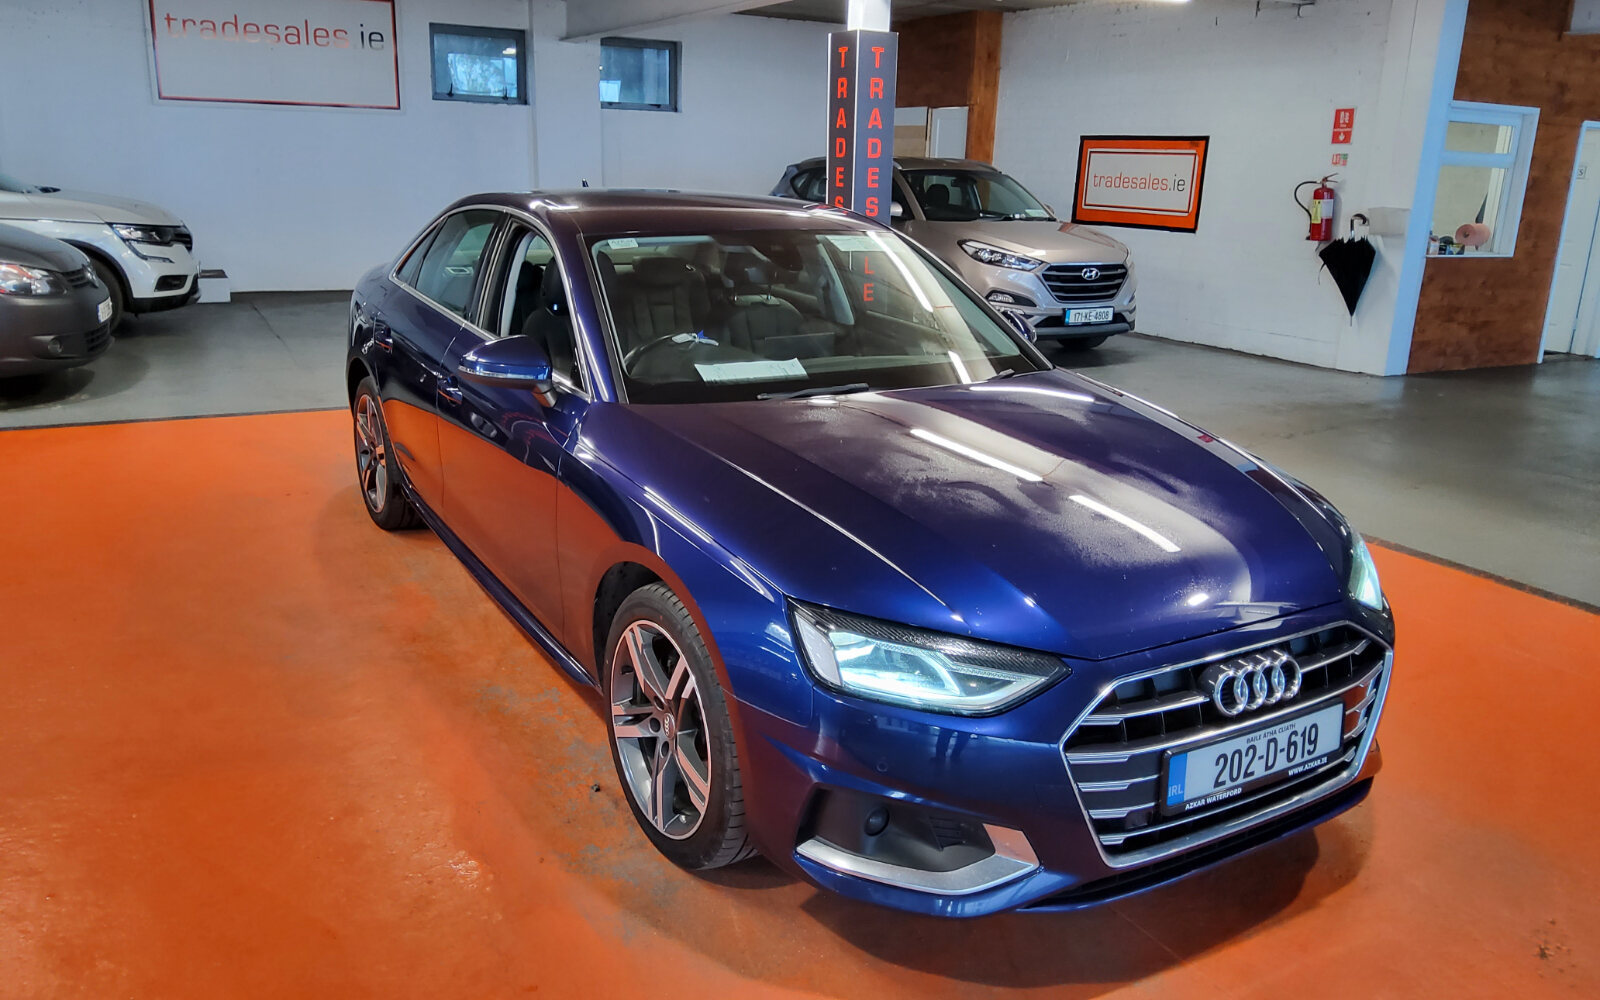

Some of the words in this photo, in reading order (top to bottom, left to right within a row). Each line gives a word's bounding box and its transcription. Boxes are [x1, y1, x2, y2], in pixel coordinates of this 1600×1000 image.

[1093, 171, 1186, 192] tradesales.ie
[1278, 723, 1296, 734] CLIATH
[1213, 723, 1319, 789] 202-D-619
[1288, 756, 1328, 776] WWW.AZKAR.IE
[1168, 783, 1184, 797] IRL
[1185, 798, 1206, 811] AZKAR
[1206, 787, 1242, 804] WATERFORD
